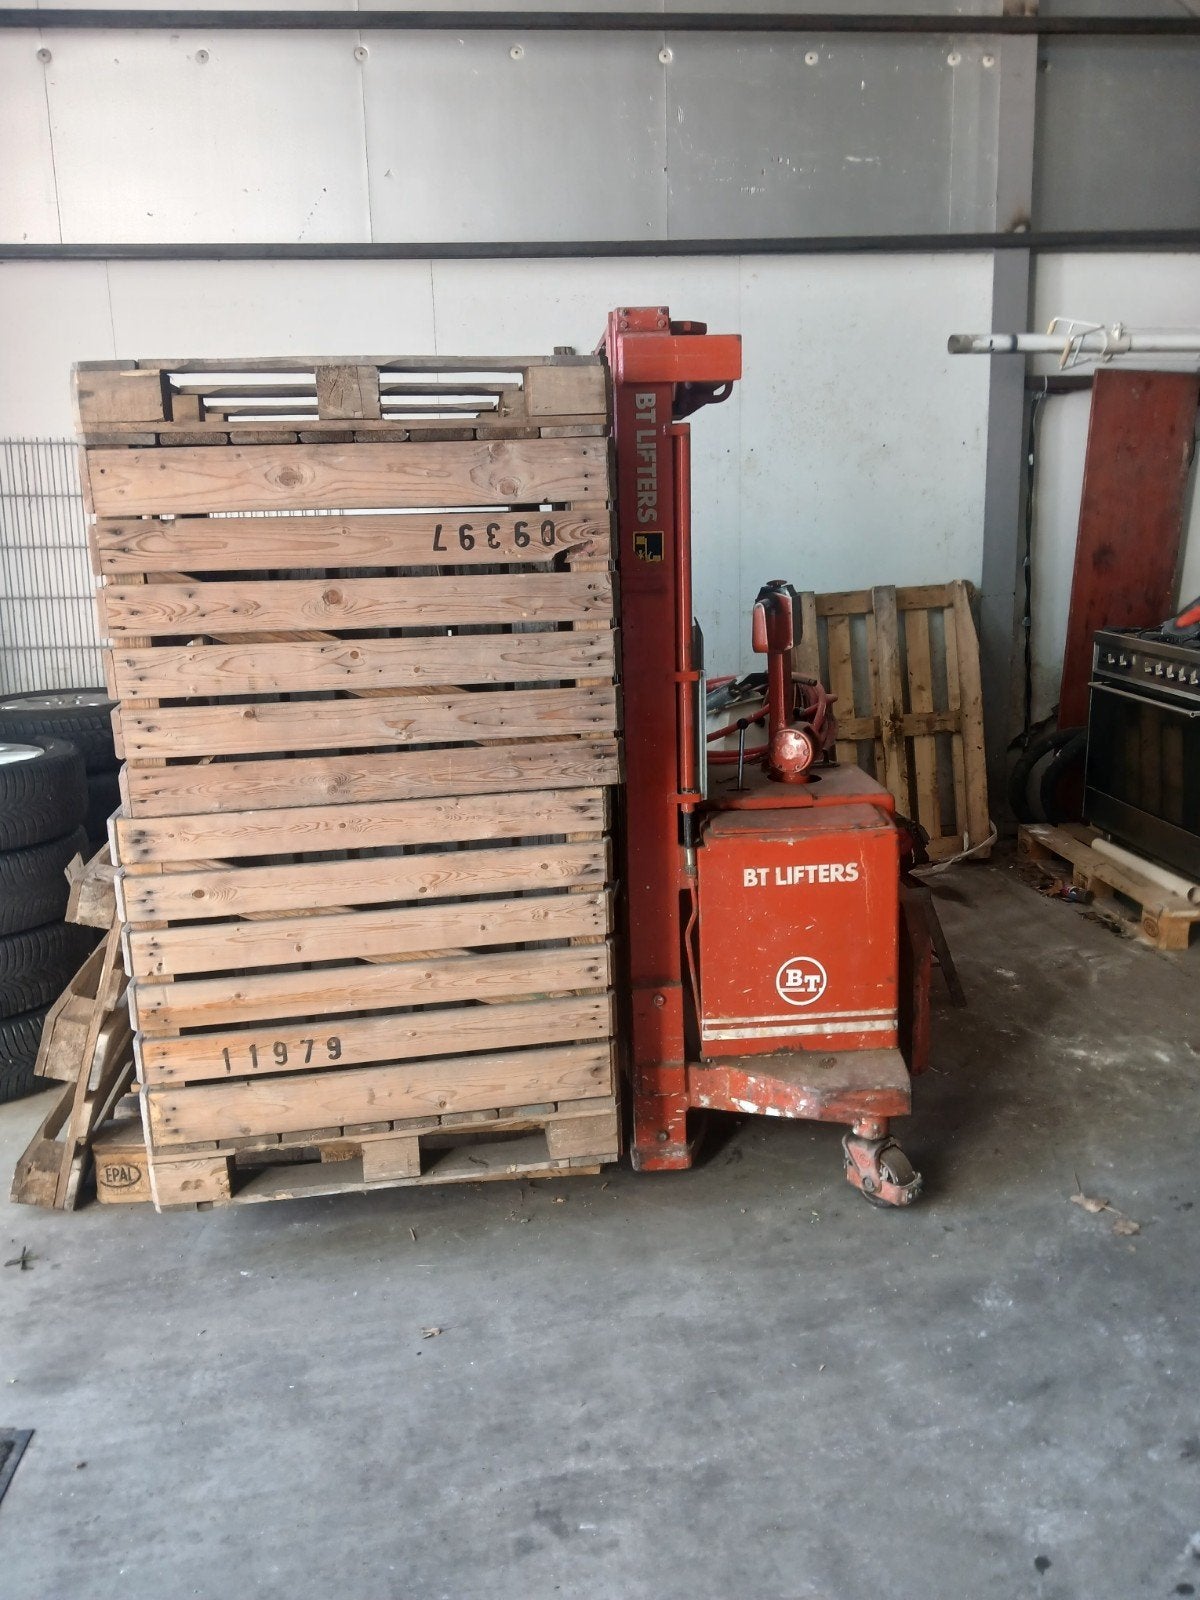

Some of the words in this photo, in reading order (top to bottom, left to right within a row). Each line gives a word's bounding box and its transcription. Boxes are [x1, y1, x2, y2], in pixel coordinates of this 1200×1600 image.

[635, 393, 657, 424] BT
[636, 430, 657, 523] LIFTERS
[433, 520, 555, 551] 09397
[743, 868, 770, 887] BT
[775, 862, 859, 886] LIFTERS
[785, 968, 821, 993] BT
[221, 1036, 342, 1074] 11979
[105, 1166, 133, 1183] EPAL
